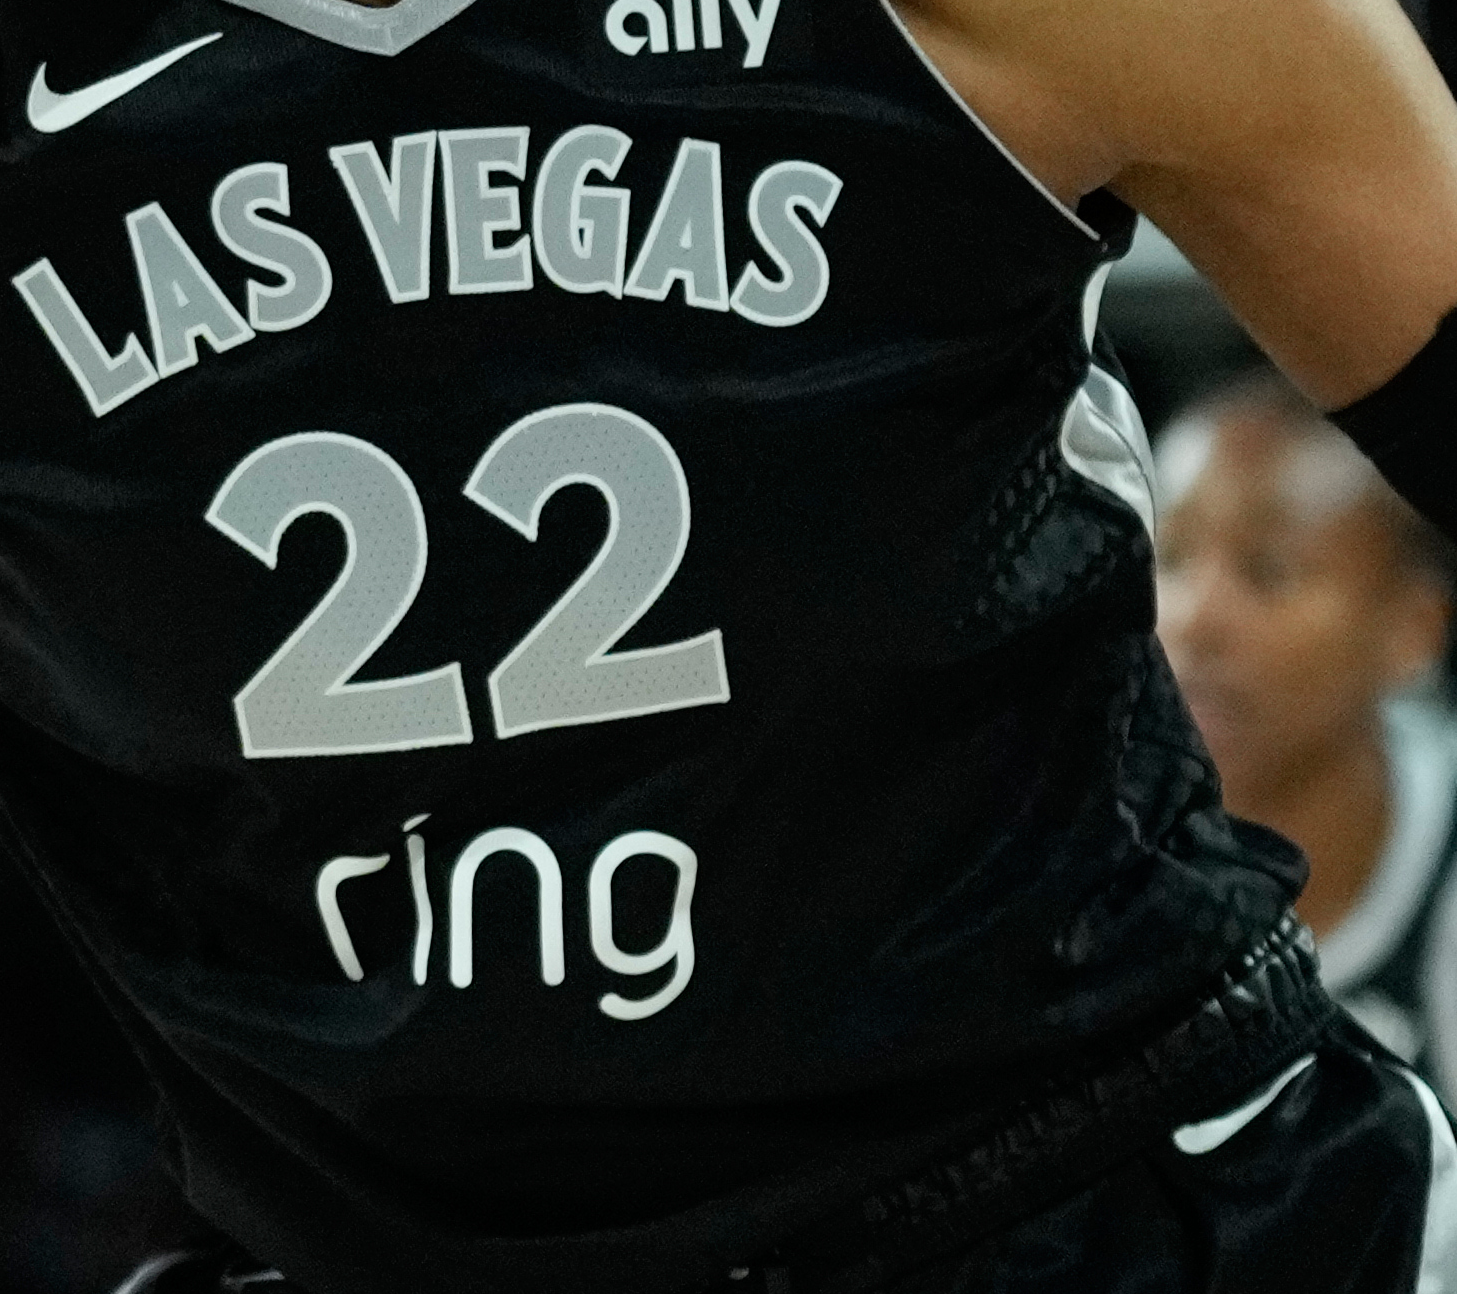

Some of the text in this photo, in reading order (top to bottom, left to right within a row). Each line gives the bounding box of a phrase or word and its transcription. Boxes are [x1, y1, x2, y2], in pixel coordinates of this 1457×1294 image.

[11, 124, 843, 417] LAS VEGAS
[204, 402, 731, 758] 22
[315, 812, 698, 1021] ring
